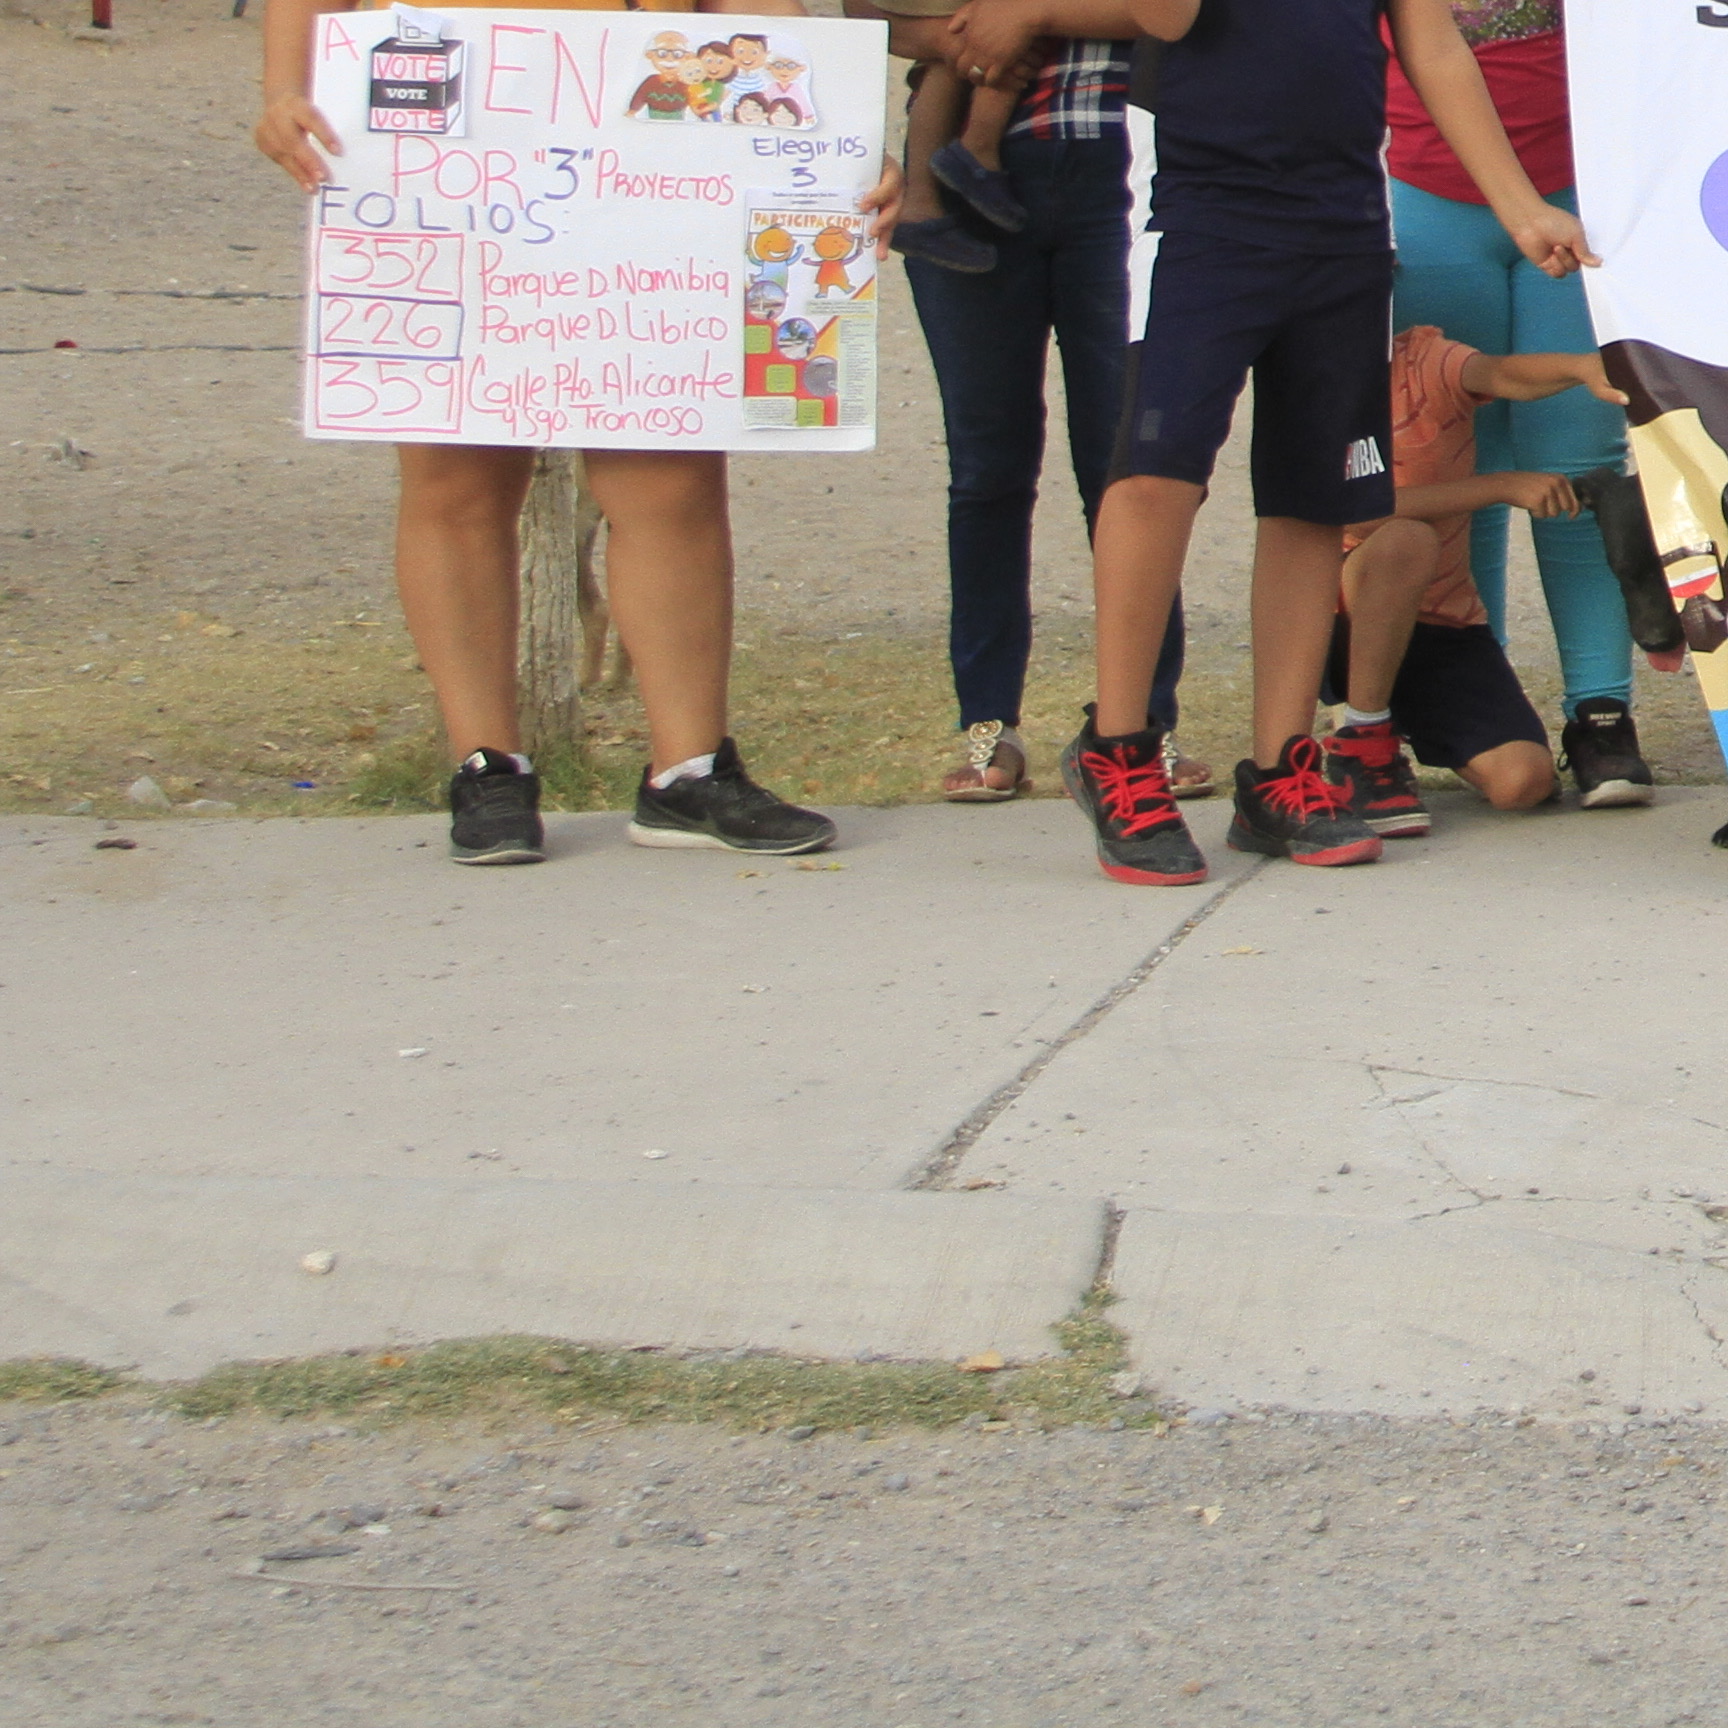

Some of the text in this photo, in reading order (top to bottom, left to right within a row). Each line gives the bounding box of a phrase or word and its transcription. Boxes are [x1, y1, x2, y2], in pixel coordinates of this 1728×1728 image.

[326, 17, 360, 61] A
[374, 54, 447, 82] VOTE
[485, 24, 609, 128] EN
[371, 109, 446, 129] VOTE
[386, 87, 428, 101] VOTE
[392, 133, 524, 209] POR
[597, 149, 734, 206] PROYECTOS
[753, 136, 868, 162] Elegir los
[790, 167, 818, 187] 3
[327, 234, 452, 295] 352
[479, 240, 579, 308] Parque
[617, 257, 730, 297] Namibia
[324, 298, 442, 349] 226
[479, 305, 591, 352] Parque
[626, 301, 728, 344] Libico
[322, 359, 453, 422] 359
[468, 354, 546, 413] Calle
[602, 350, 738, 404] Alicante
[1352, 436, 1385, 478] NBA
